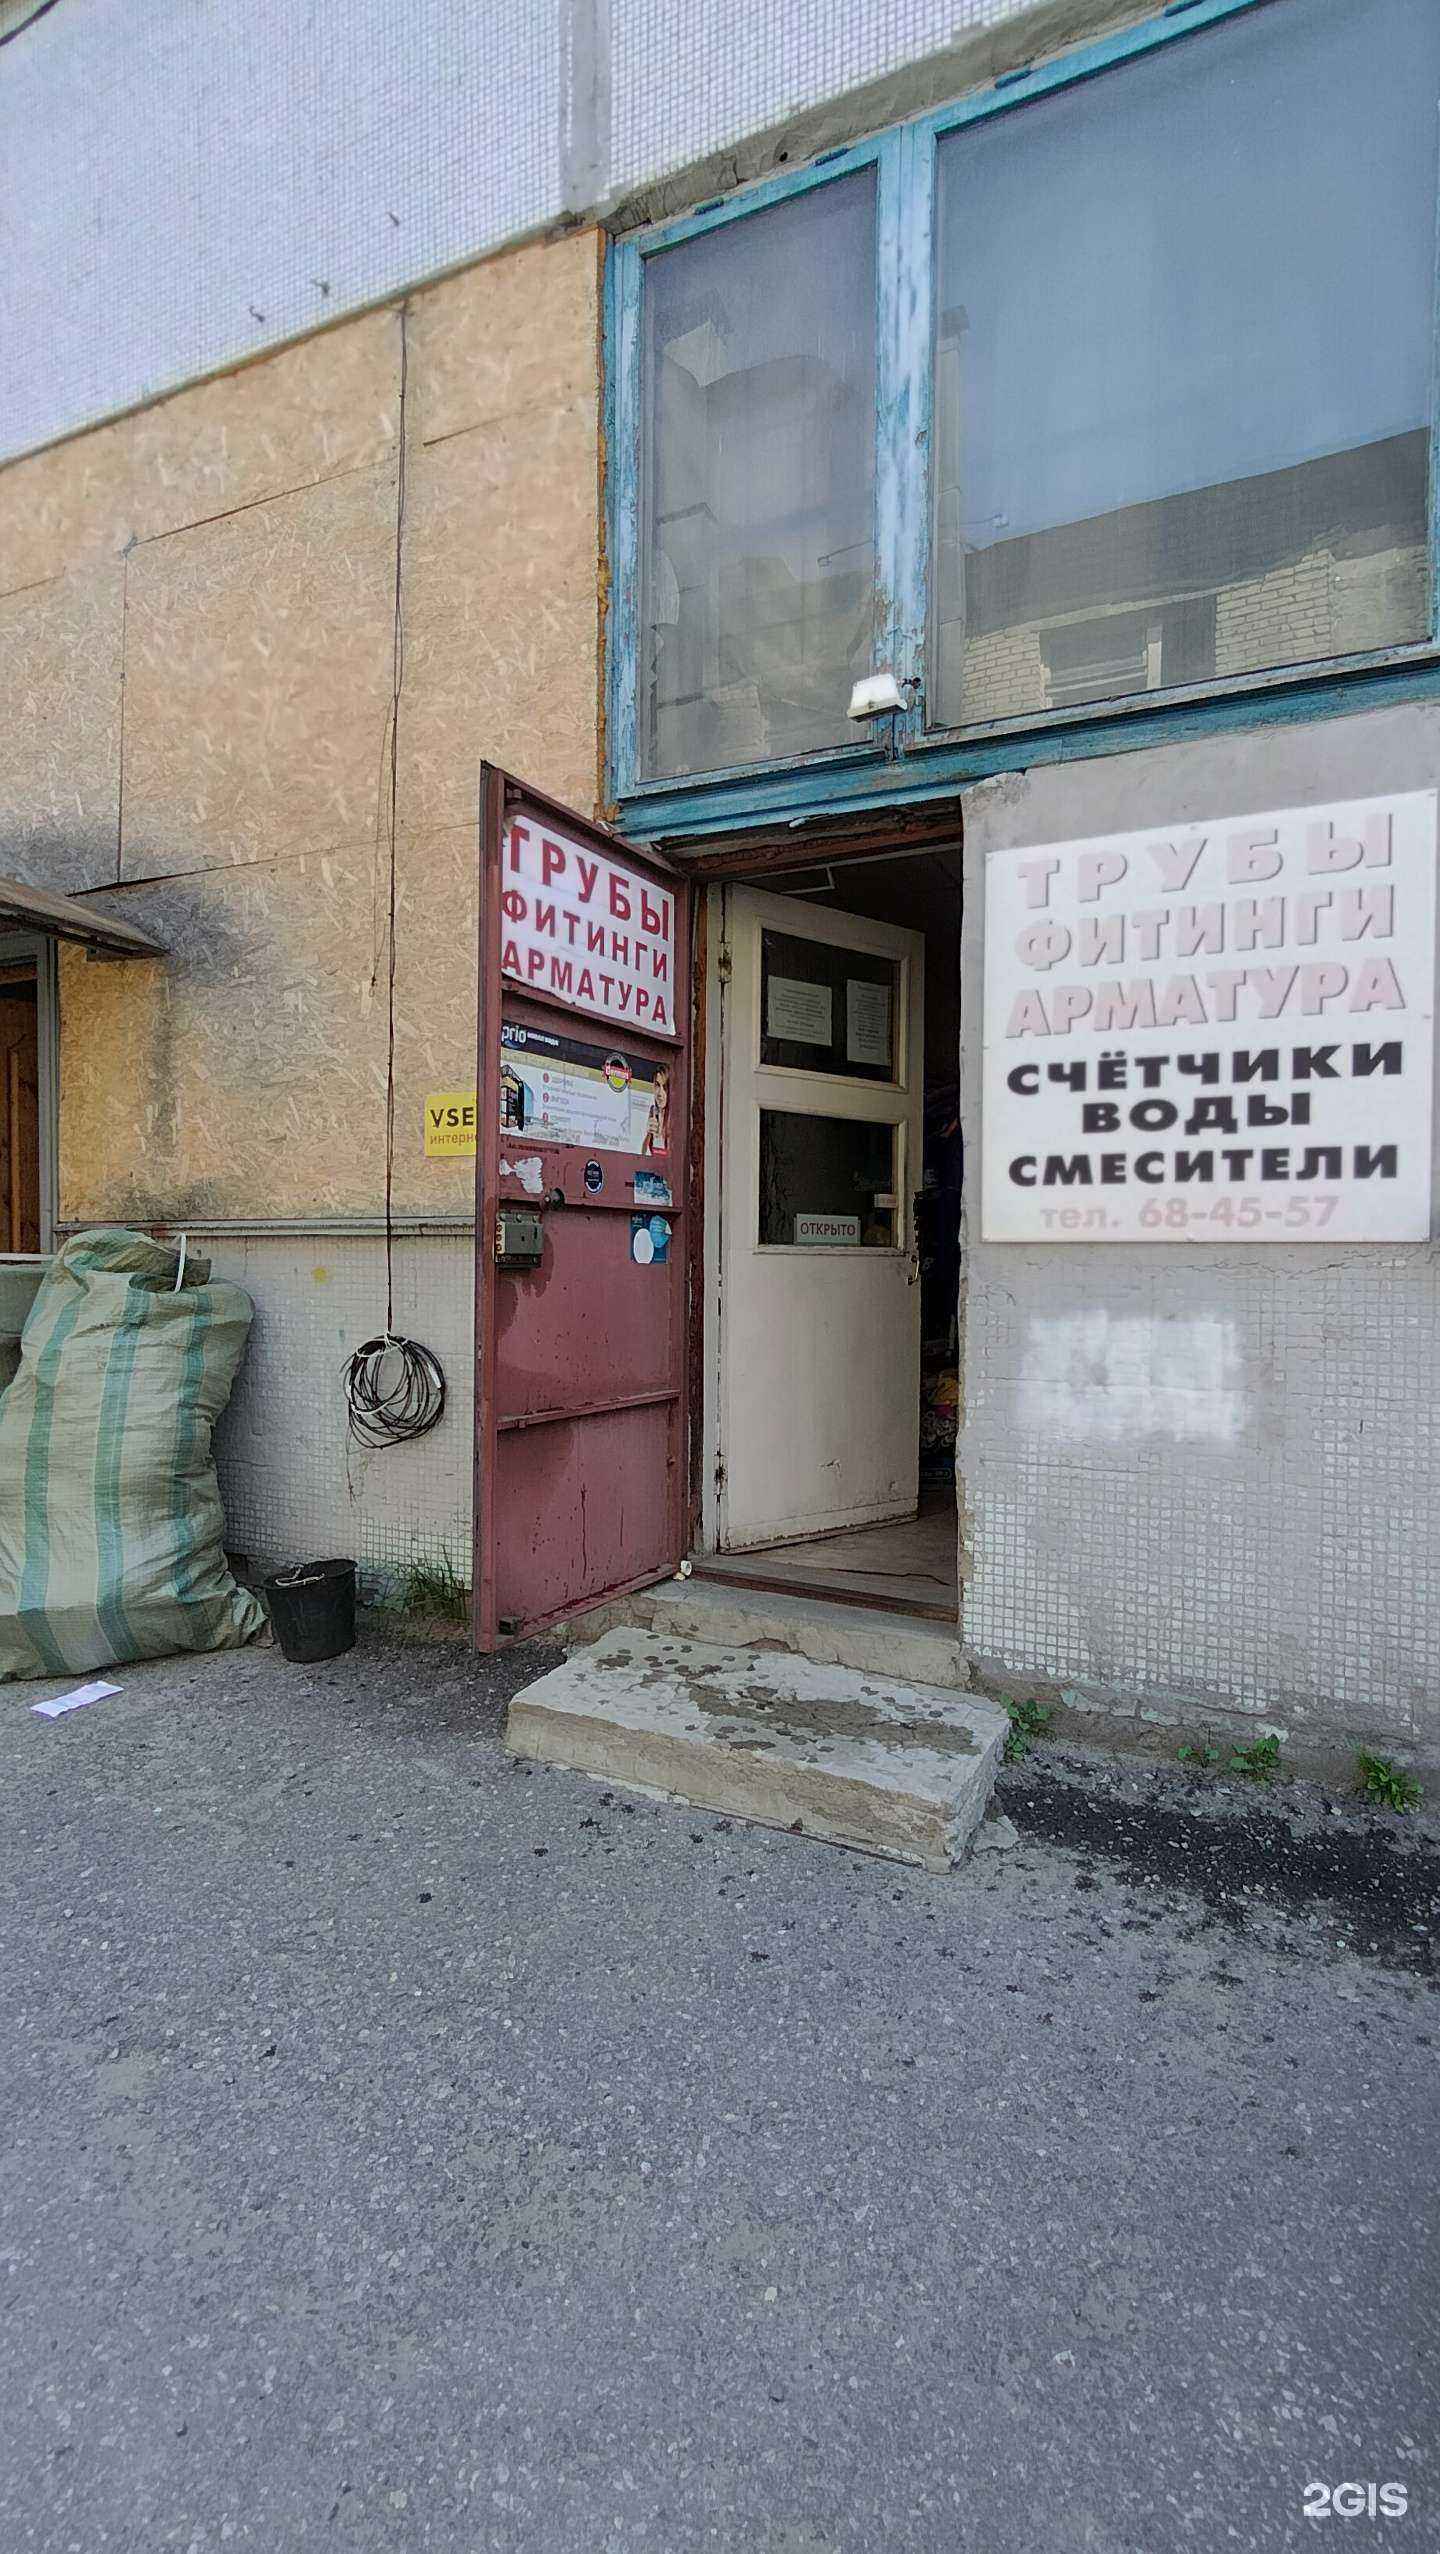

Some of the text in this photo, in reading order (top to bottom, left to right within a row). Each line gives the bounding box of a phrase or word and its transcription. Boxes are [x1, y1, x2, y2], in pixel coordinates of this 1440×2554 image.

[1016, 813, 1394, 909] ТРУБЫ
[501, 889, 668, 983] ФИТИНГИ
[1014, 884, 1395, 971] ФИТИНГИ
[501, 939, 667, 1026] АРМАТУРА
[1005, 957, 1406, 1039] АРМАТУРА
[1007, 1041, 1403, 1096] СЧЁТЧИКИ
[430, 1133, 477, 1146] интерн
[1082, 1092, 1311, 1136] ВОДЫ
[1008, 1145, 1398, 1187] СМЕСИТЕЛИ
[800, 1221, 857, 1238] ОТКРЫТО
[1040, 1196, 1340, 1230] тел. 68-45-57
